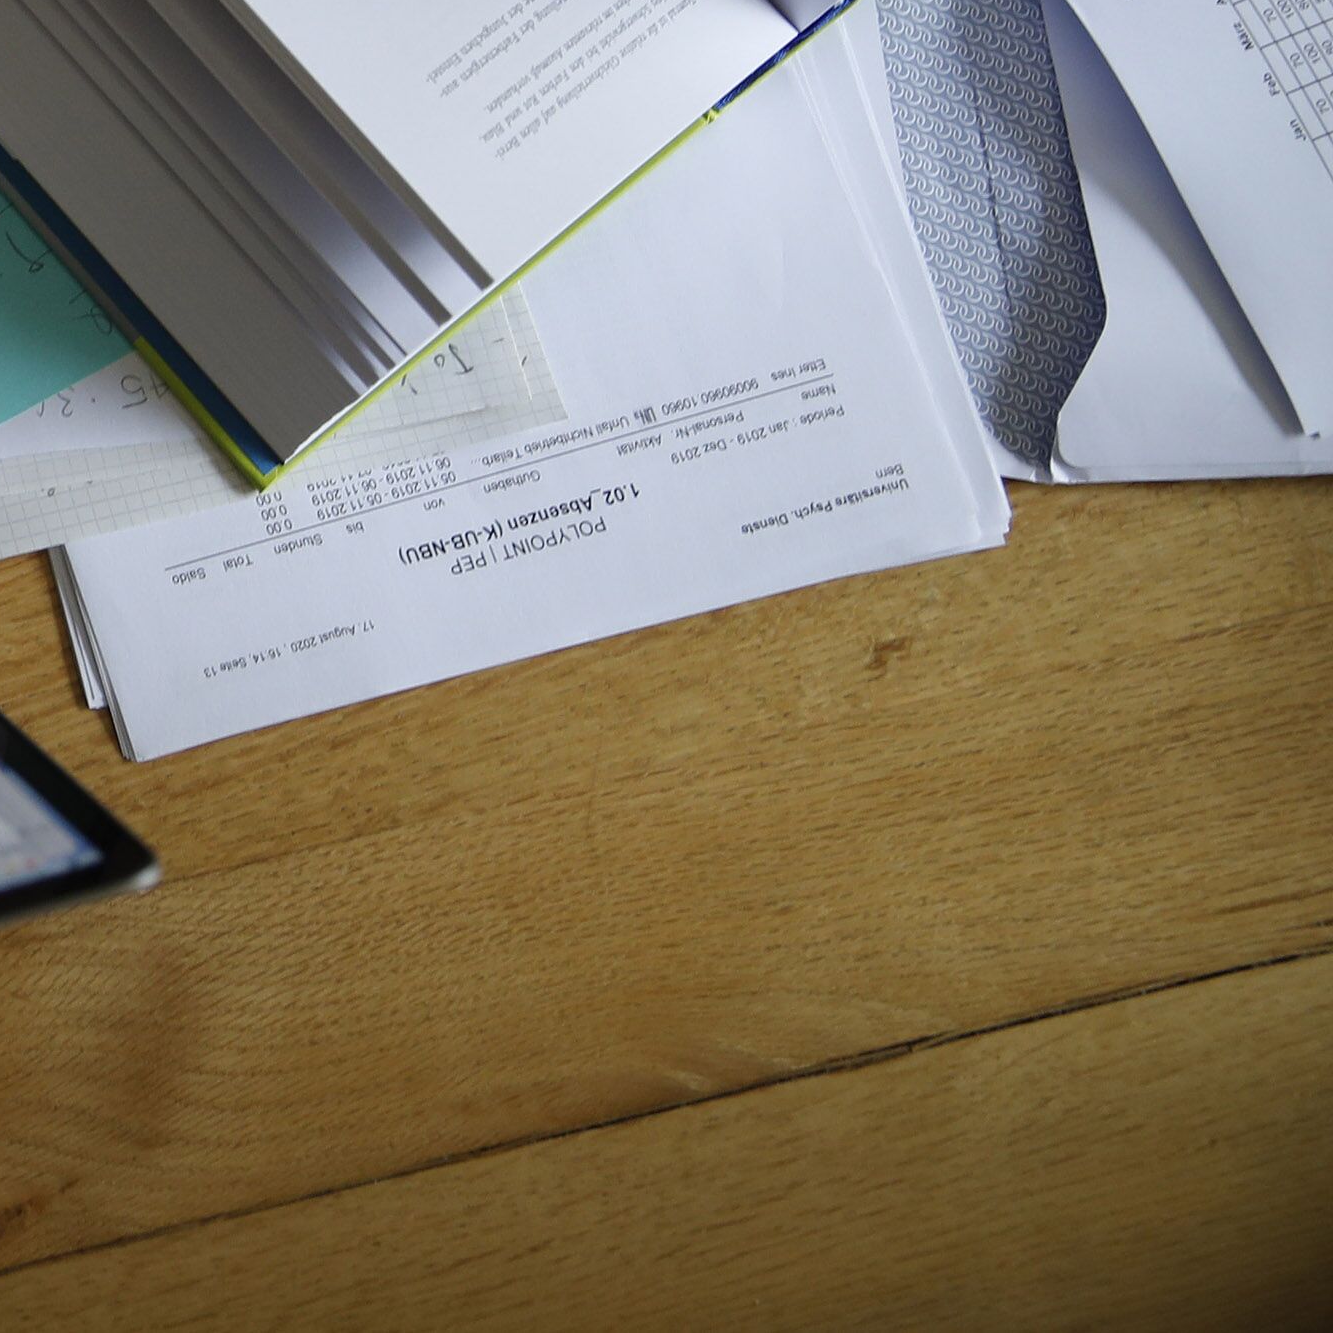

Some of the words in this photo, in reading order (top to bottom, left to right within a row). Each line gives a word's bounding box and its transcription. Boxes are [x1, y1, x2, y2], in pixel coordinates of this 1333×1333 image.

[507, 3, 525, 21] der
[518, 18, 536, 37] der
[459, 30, 519, 83] Farbenergien
[568, 56, 586, 74] den
[539, 69, 569, 98] Farben
[1258, 70, 1283, 96] Feb
[522, 93, 539, 111] Rot
[504, 107, 523, 126] und
[541, 105, 558, 123] auf
[519, 117, 542, 140] allen
[1285, 117, 1310, 143] Jan
[800, 382, 836, 403] Name
[595, 414, 630, 436] Unfall
[669, 407, 744, 442] Personal-Nr.
[798, 402, 845, 428] Periode
[735, 425, 766, 445] 2019
[766, 418, 790, 435] Jan
[669, 445, 701, 465] 2019
[702, 437, 727, 455] Dez
[482, 467, 541, 497] Guthaben
[874, 462, 904, 481] Bern
[389, 469, 456, 500] 05.11.2019
[833, 474, 909, 510] Universitäre
[259, 503, 287, 521] 0.00
[315, 490, 382, 521] 05.11.2019
[422, 496, 445, 511] von
[505, 477, 640, 535] 1.02_Absenzen
[789, 496, 832, 522] Psych.
[264, 517, 292, 535] 0.00
[345, 520, 364, 536] bis
[740, 511, 788, 537] Dienste
[272, 532, 323, 558] Stunden
[396, 516, 504, 568] (K-UB-NBU)
[500, 513, 607, 562] POLYPOINT
[221, 552, 252, 572] Total
[447, 549, 487, 576] PEP
[170, 566, 206, 587] Saldo
[317, 622, 356, 644] August
[358, 618, 375, 632] 17.
[289, 634, 317, 652] 2020
[219, 655, 247, 674] Seite
